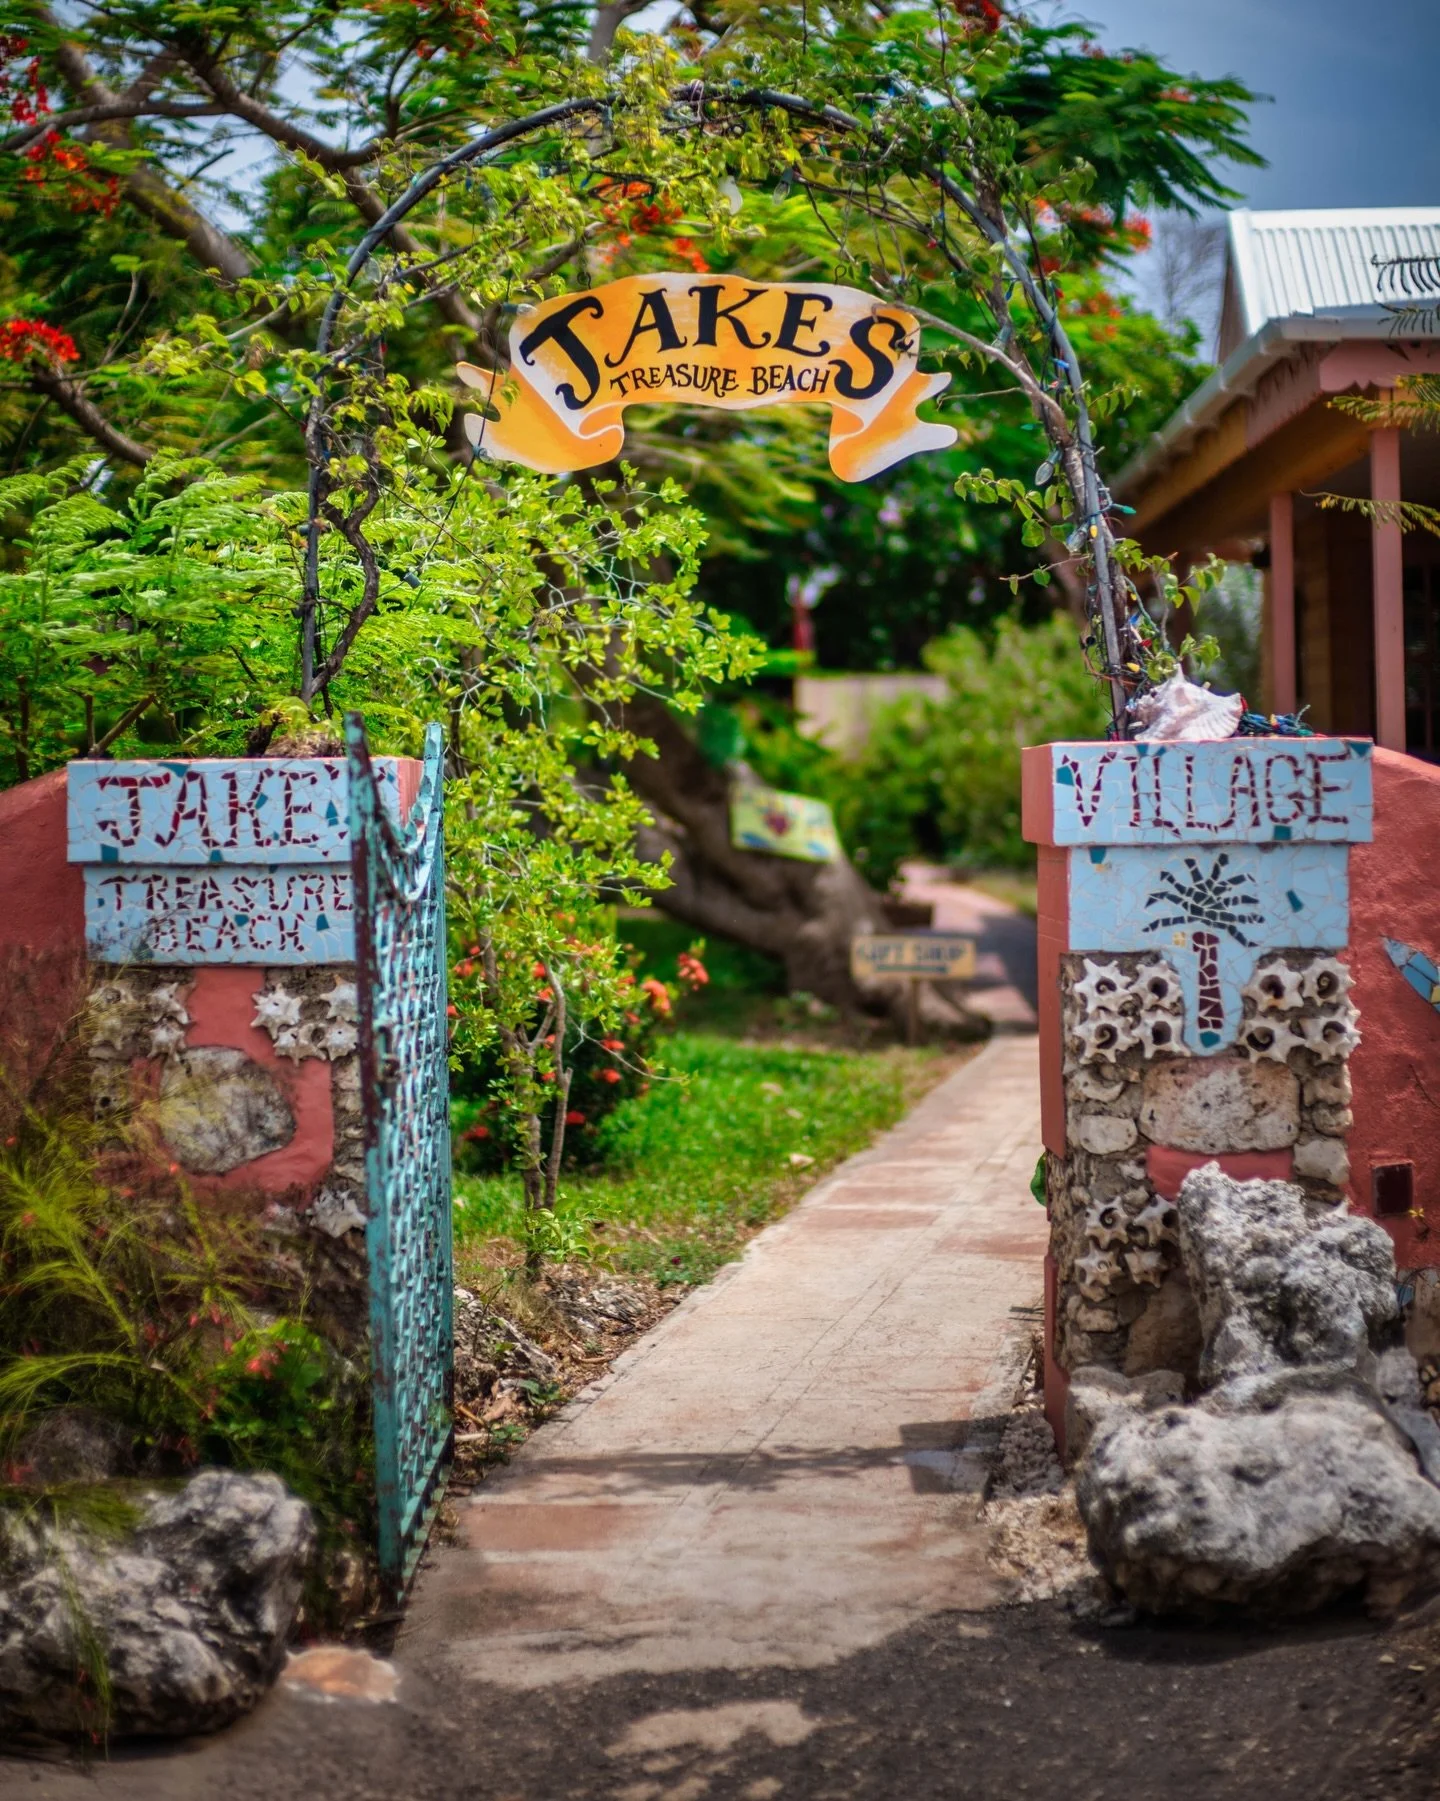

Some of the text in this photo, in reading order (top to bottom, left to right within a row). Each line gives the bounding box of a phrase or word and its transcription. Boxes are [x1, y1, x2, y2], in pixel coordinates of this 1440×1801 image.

[519, 284, 914, 410] JAKES
[610, 362, 831, 398] TREASURE BEACH
[1061, 751, 1351, 838] VILLAGE
[99, 873, 354, 912] TREASURE
[149, 913, 306, 952] BEACH
